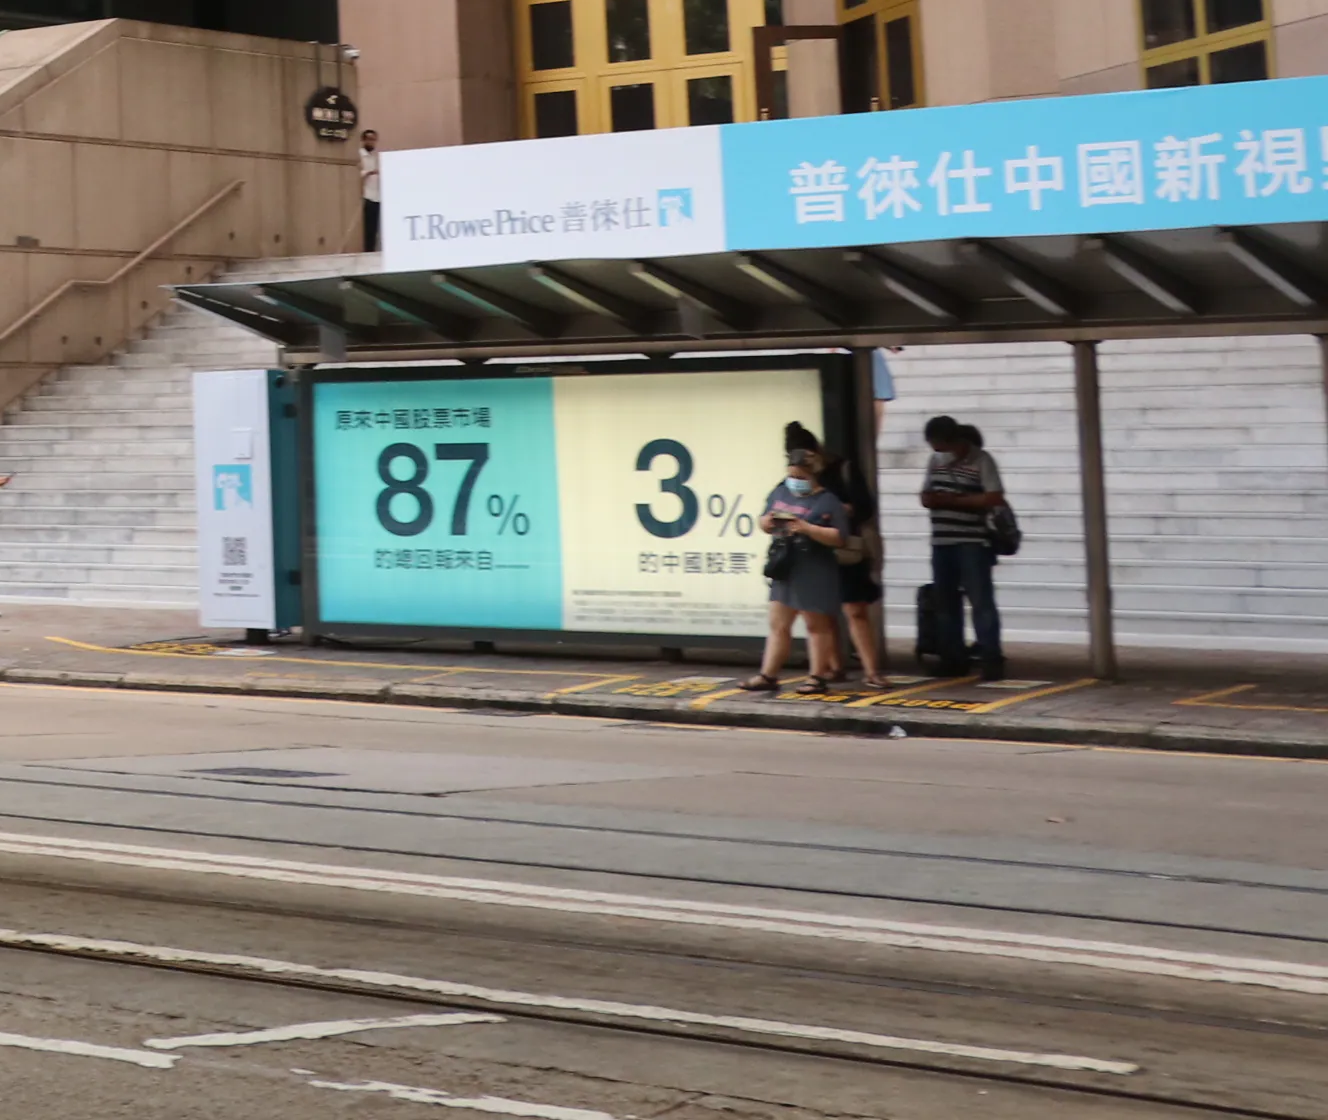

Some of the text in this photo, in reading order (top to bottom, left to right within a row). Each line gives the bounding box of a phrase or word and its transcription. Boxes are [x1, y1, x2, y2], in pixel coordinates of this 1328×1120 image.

[789, 126, 1328, 224] 普徠仕中國新視
[559, 196, 652, 233] 普徠仕
[336, 407, 491, 430] 原來中國股票市場
